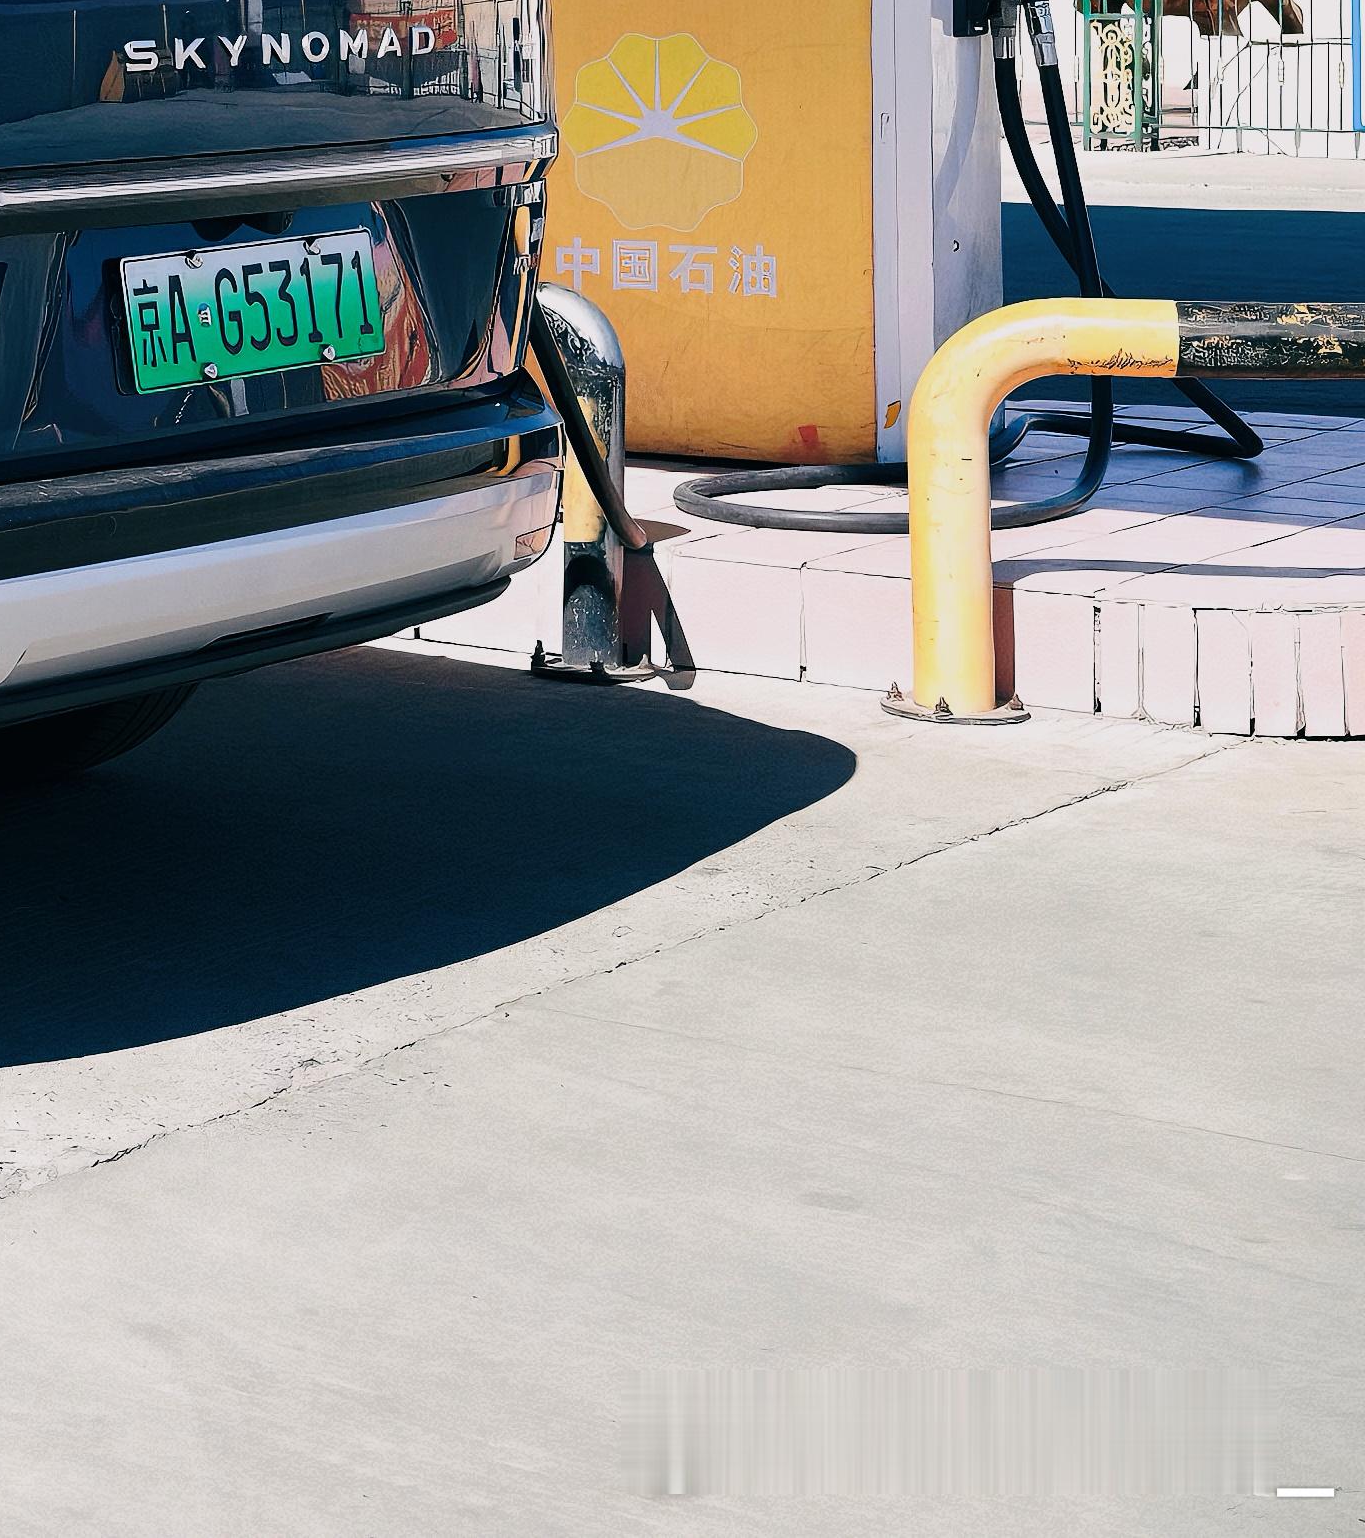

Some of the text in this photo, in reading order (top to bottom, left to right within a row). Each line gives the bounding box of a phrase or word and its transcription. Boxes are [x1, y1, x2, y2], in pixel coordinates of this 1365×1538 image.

[124, 25, 436, 72] SKYNOMAD
[555, 237, 777, 298] 中国石油
